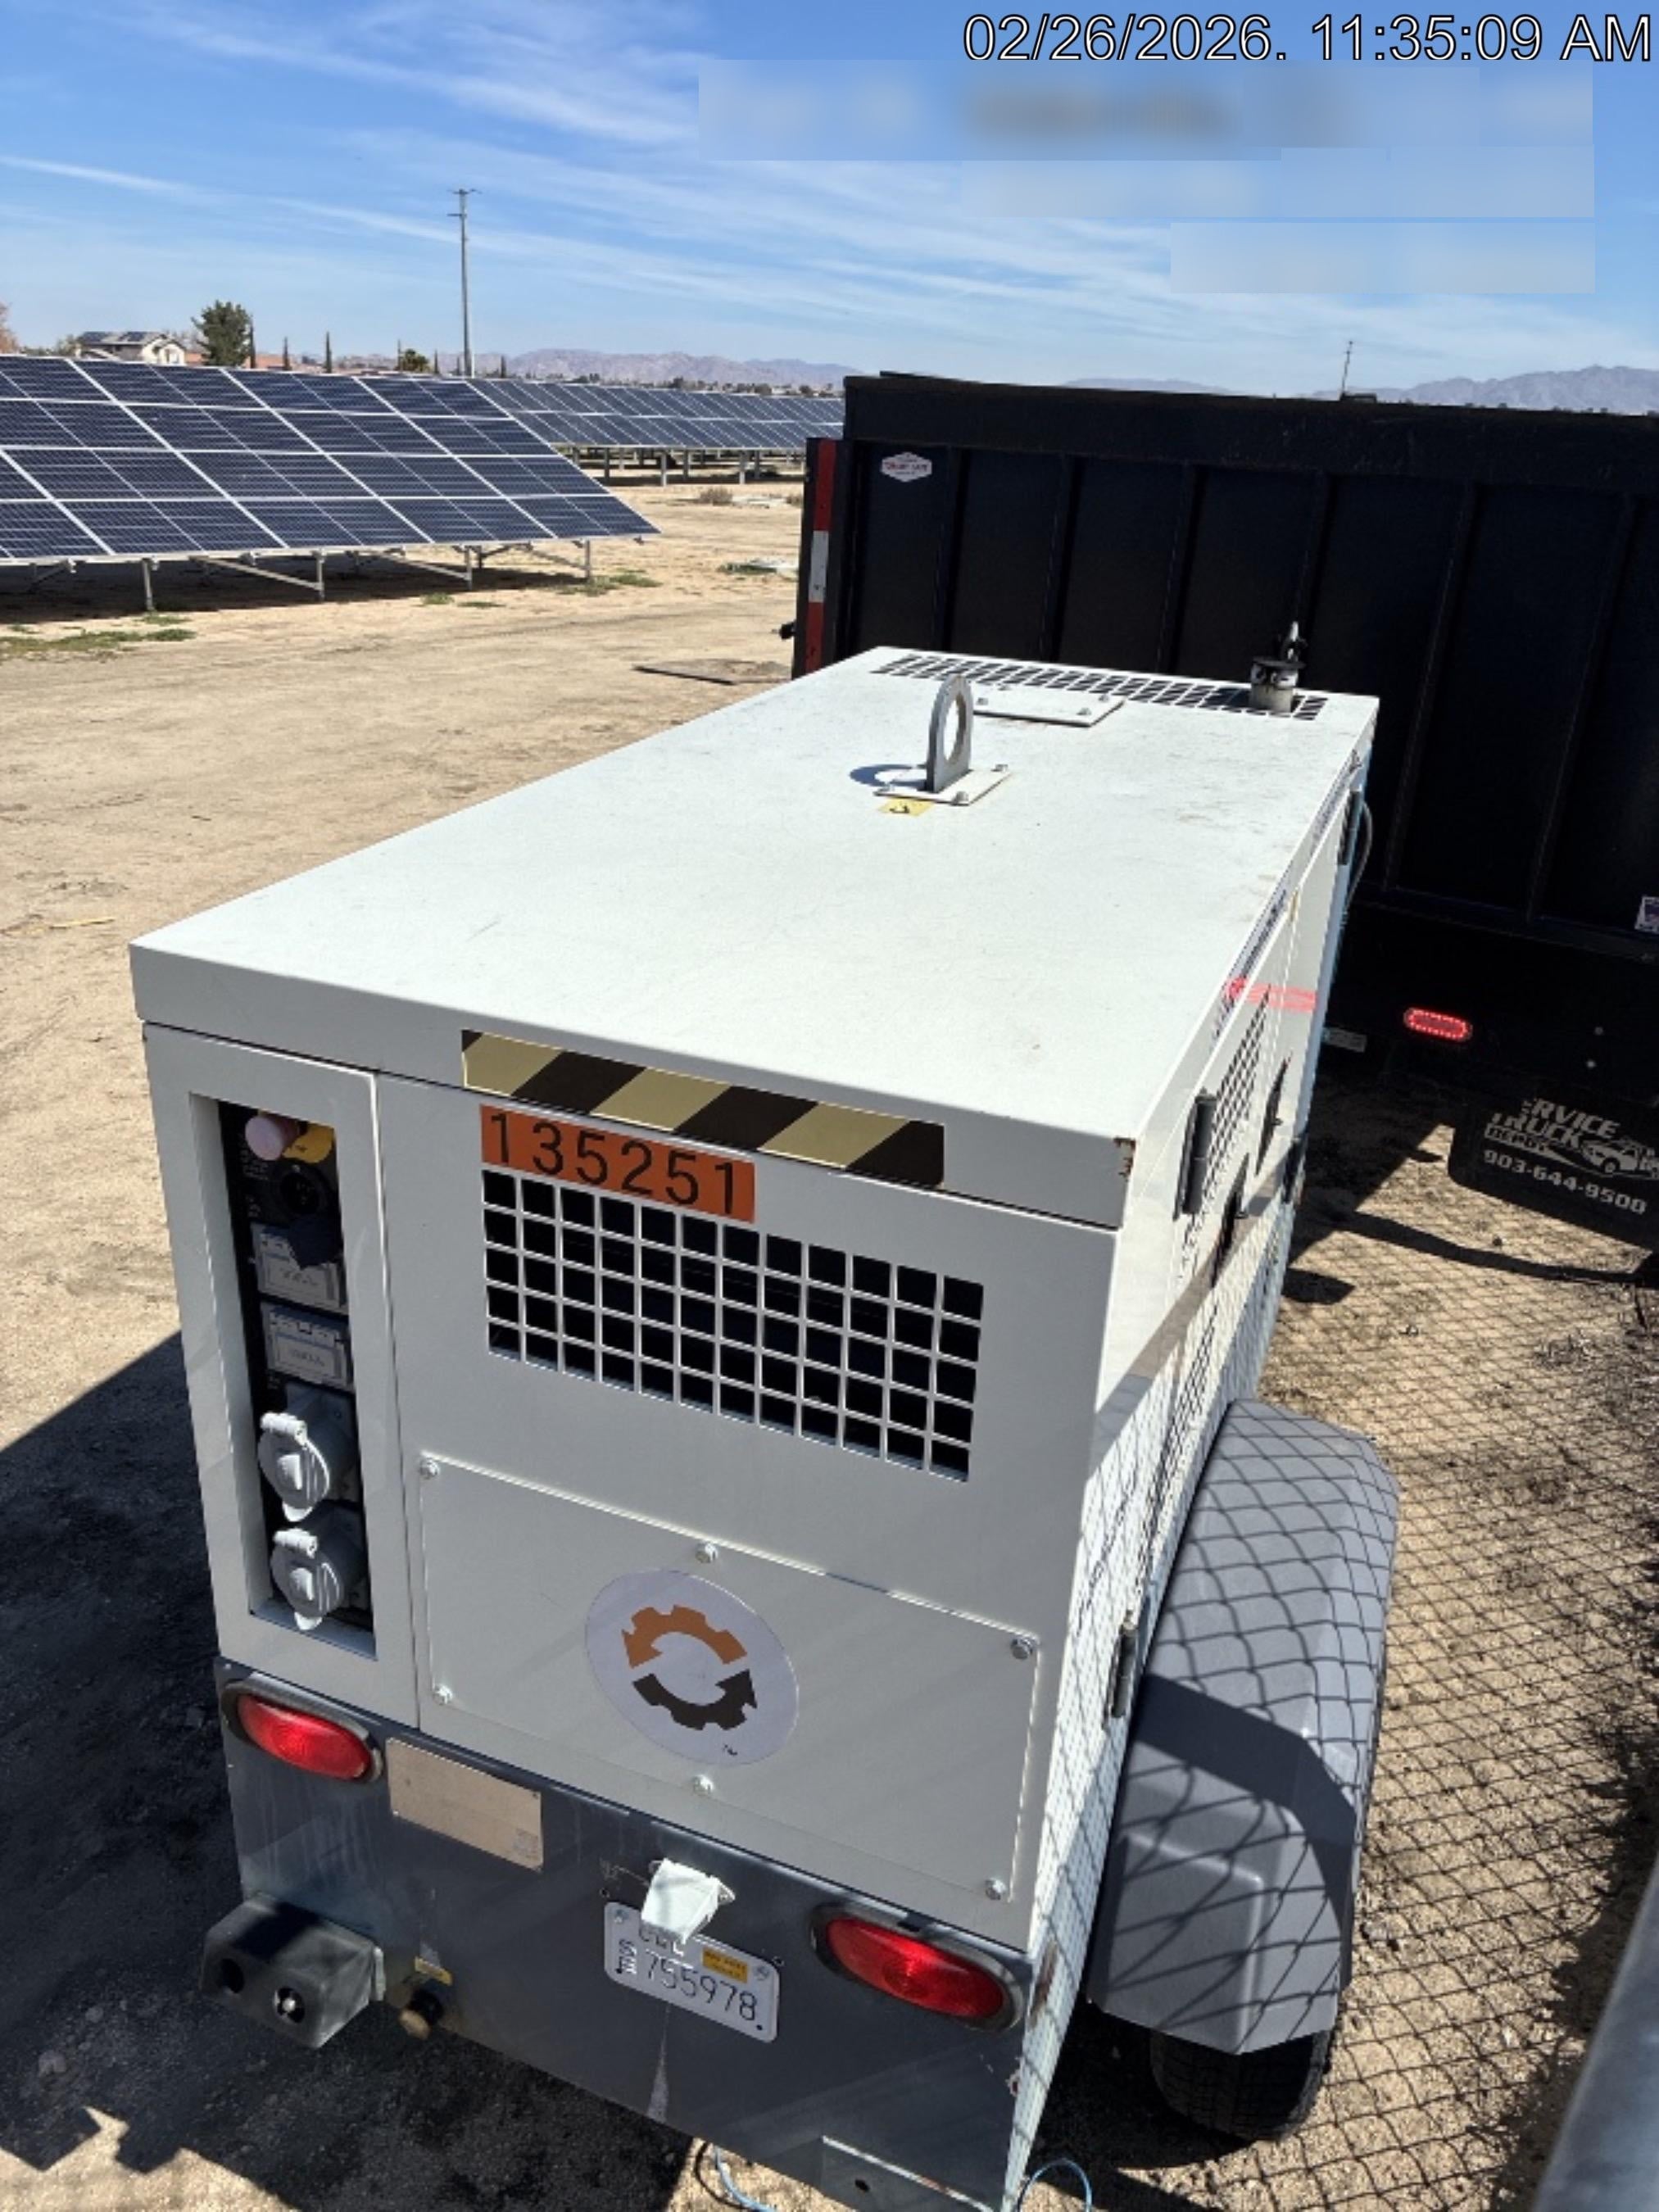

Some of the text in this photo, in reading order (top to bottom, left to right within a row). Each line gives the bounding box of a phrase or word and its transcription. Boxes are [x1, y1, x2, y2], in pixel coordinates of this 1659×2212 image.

[491, 1113, 735, 1214] 135251
[1484, 1149, 1647, 1214] 903-644-9500
[646, 1950, 758, 2021] 755978
